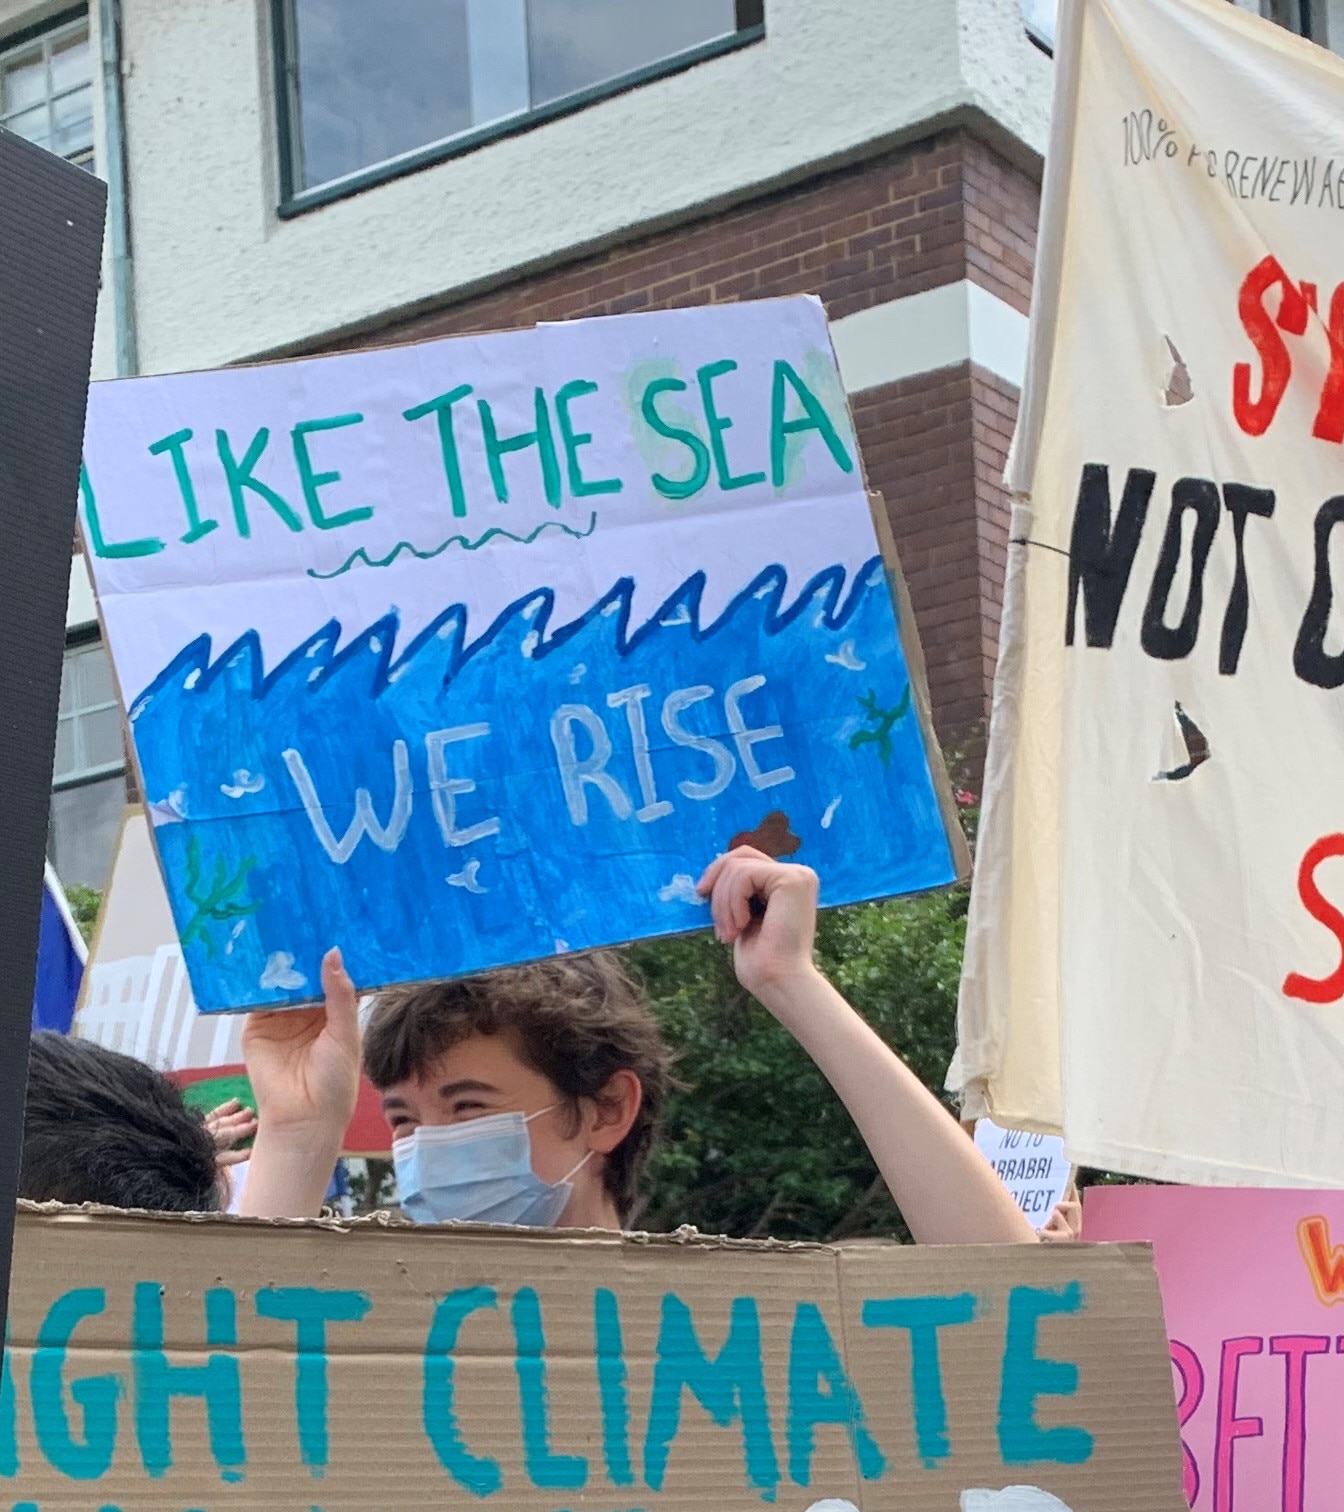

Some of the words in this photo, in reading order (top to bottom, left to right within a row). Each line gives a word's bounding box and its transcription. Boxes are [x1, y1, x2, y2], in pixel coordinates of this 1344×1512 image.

[1122, 108, 1178, 167] 100%
[80, 410, 373, 559] LIKE
[404, 378, 625, 518] THE
[639, 357, 853, 500] SEA
[1064, 462, 1277, 676] NOT
[282, 720, 500, 865] WE
[550, 673, 796, 827] RISE
[999, 1130, 1024, 1149] NO
[422, 1281, 1095, 1502] CLIMATE
